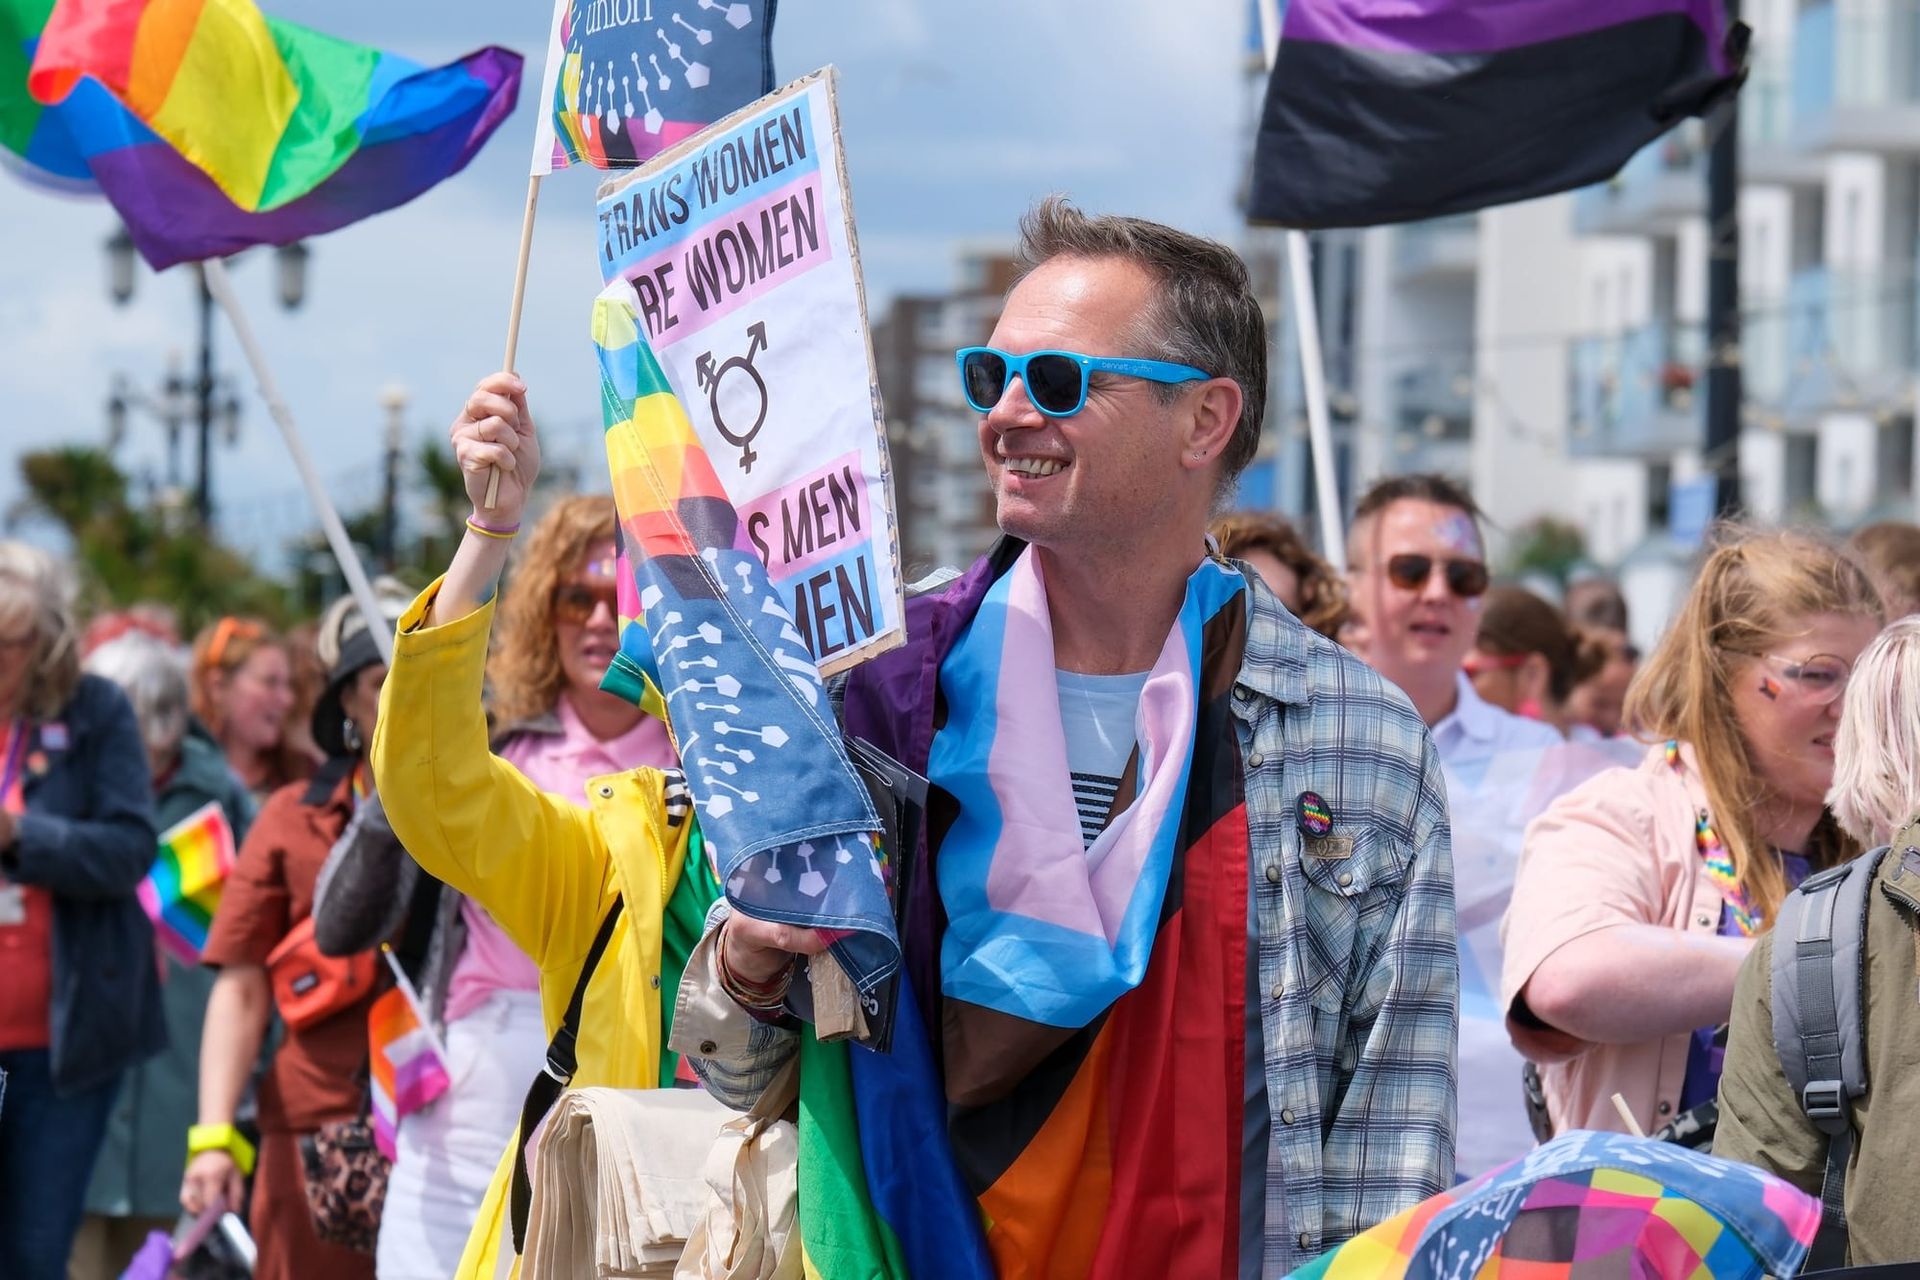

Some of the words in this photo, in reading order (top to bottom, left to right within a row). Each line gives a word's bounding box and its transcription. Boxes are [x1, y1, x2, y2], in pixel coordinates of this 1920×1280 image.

[600, 174, 690, 262] TRANS
[692, 107, 807, 210] WOMEN
[632, 262, 679, 339] RE
[685, 187, 819, 312] WOMEN
[781, 465, 861, 564] MEN
